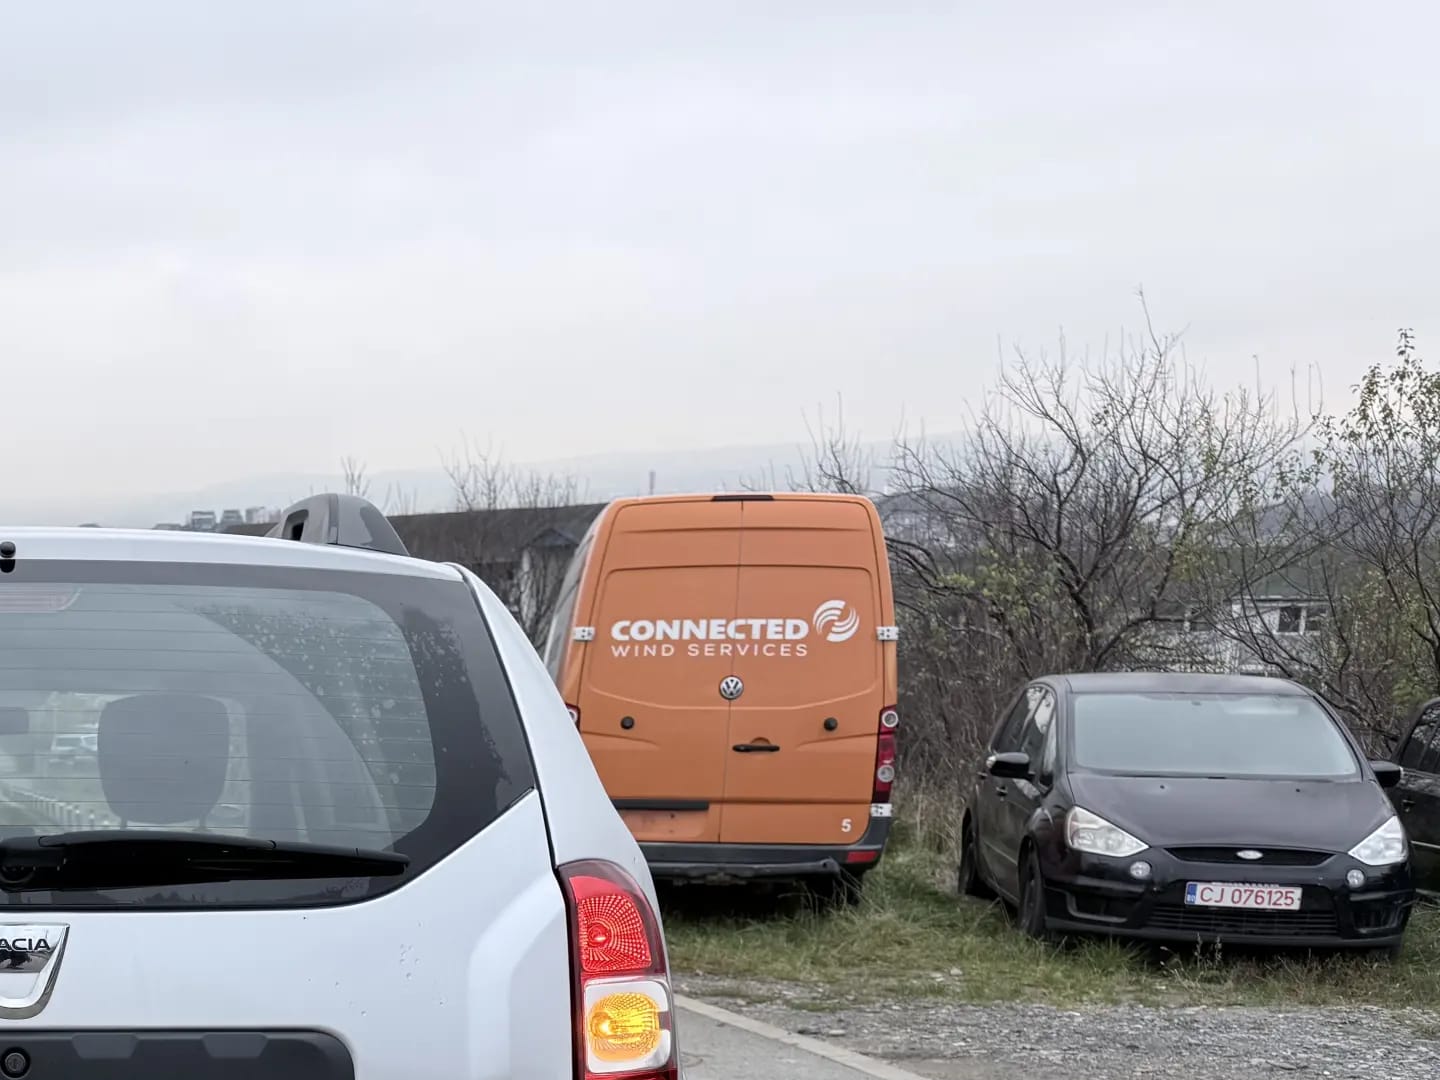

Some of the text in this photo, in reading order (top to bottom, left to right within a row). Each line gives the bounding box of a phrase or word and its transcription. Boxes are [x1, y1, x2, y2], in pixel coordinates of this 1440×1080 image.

[610, 618, 809, 641] CONNECTED
[611, 643, 808, 657] WIND SERVICES
[841, 818, 851, 832] 5
[1200, 887, 1224, 903] CJ
[1231, 888, 1295, 906] 076125
